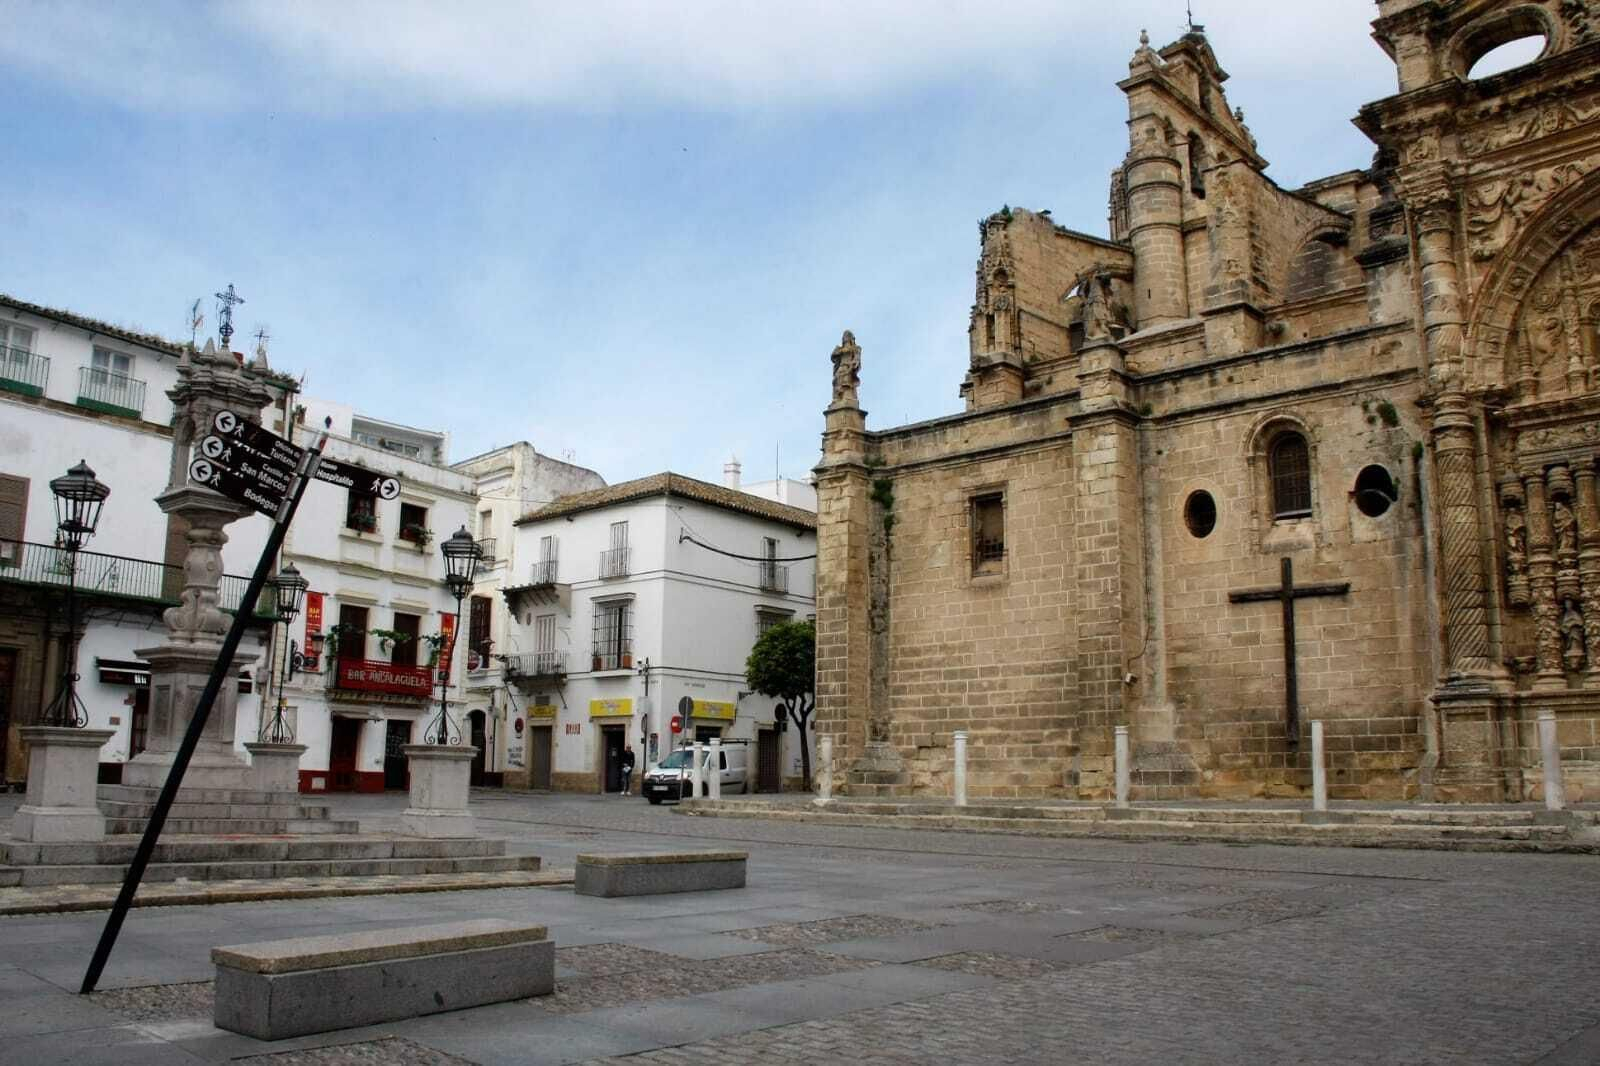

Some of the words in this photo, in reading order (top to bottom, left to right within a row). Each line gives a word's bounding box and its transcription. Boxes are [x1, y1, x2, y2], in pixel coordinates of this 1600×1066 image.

[270, 448, 297, 468] Turismo
[240, 463, 257, 477] San
[257, 470, 287, 492] Marcos
[244, 488, 278, 511] Bodegas
[347, 669, 366, 681] BAR
